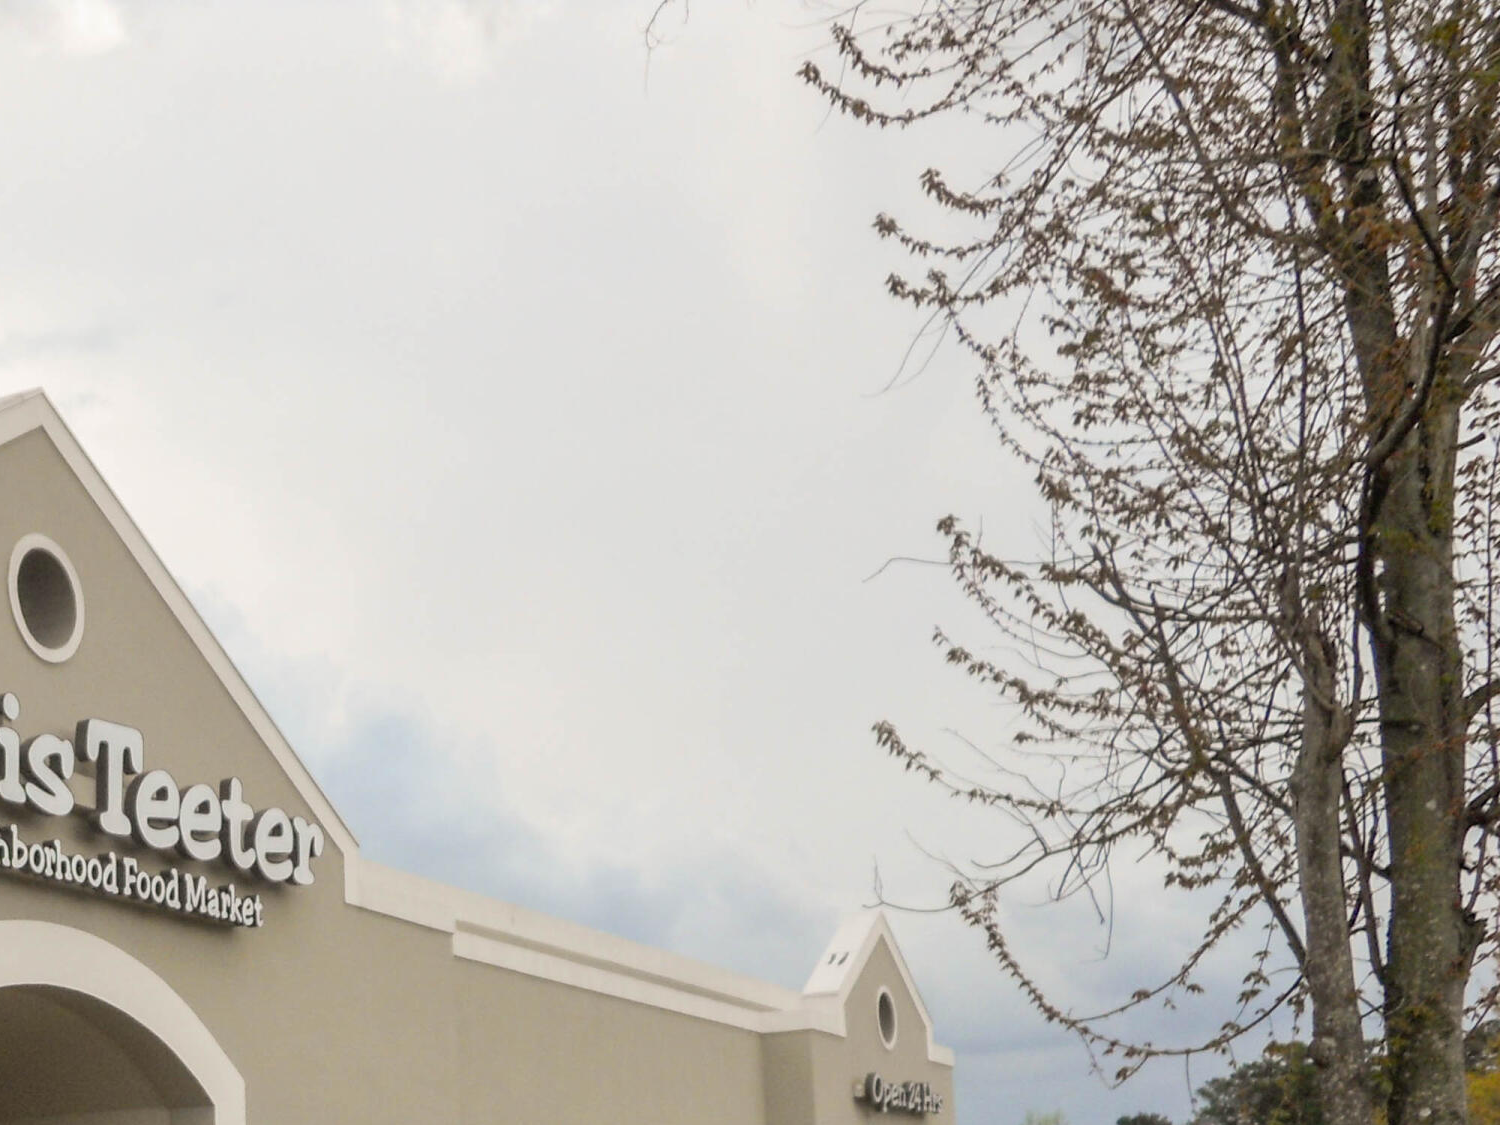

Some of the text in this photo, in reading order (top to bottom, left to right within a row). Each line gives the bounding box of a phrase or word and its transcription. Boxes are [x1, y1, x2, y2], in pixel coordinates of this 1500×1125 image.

[78, 717, 325, 886] Teeter
[122, 855, 181, 910] Food
[184, 872, 264, 928] Market
[869, 1072, 907, 1113] Open
[908, 1082, 922, 1112] 24
